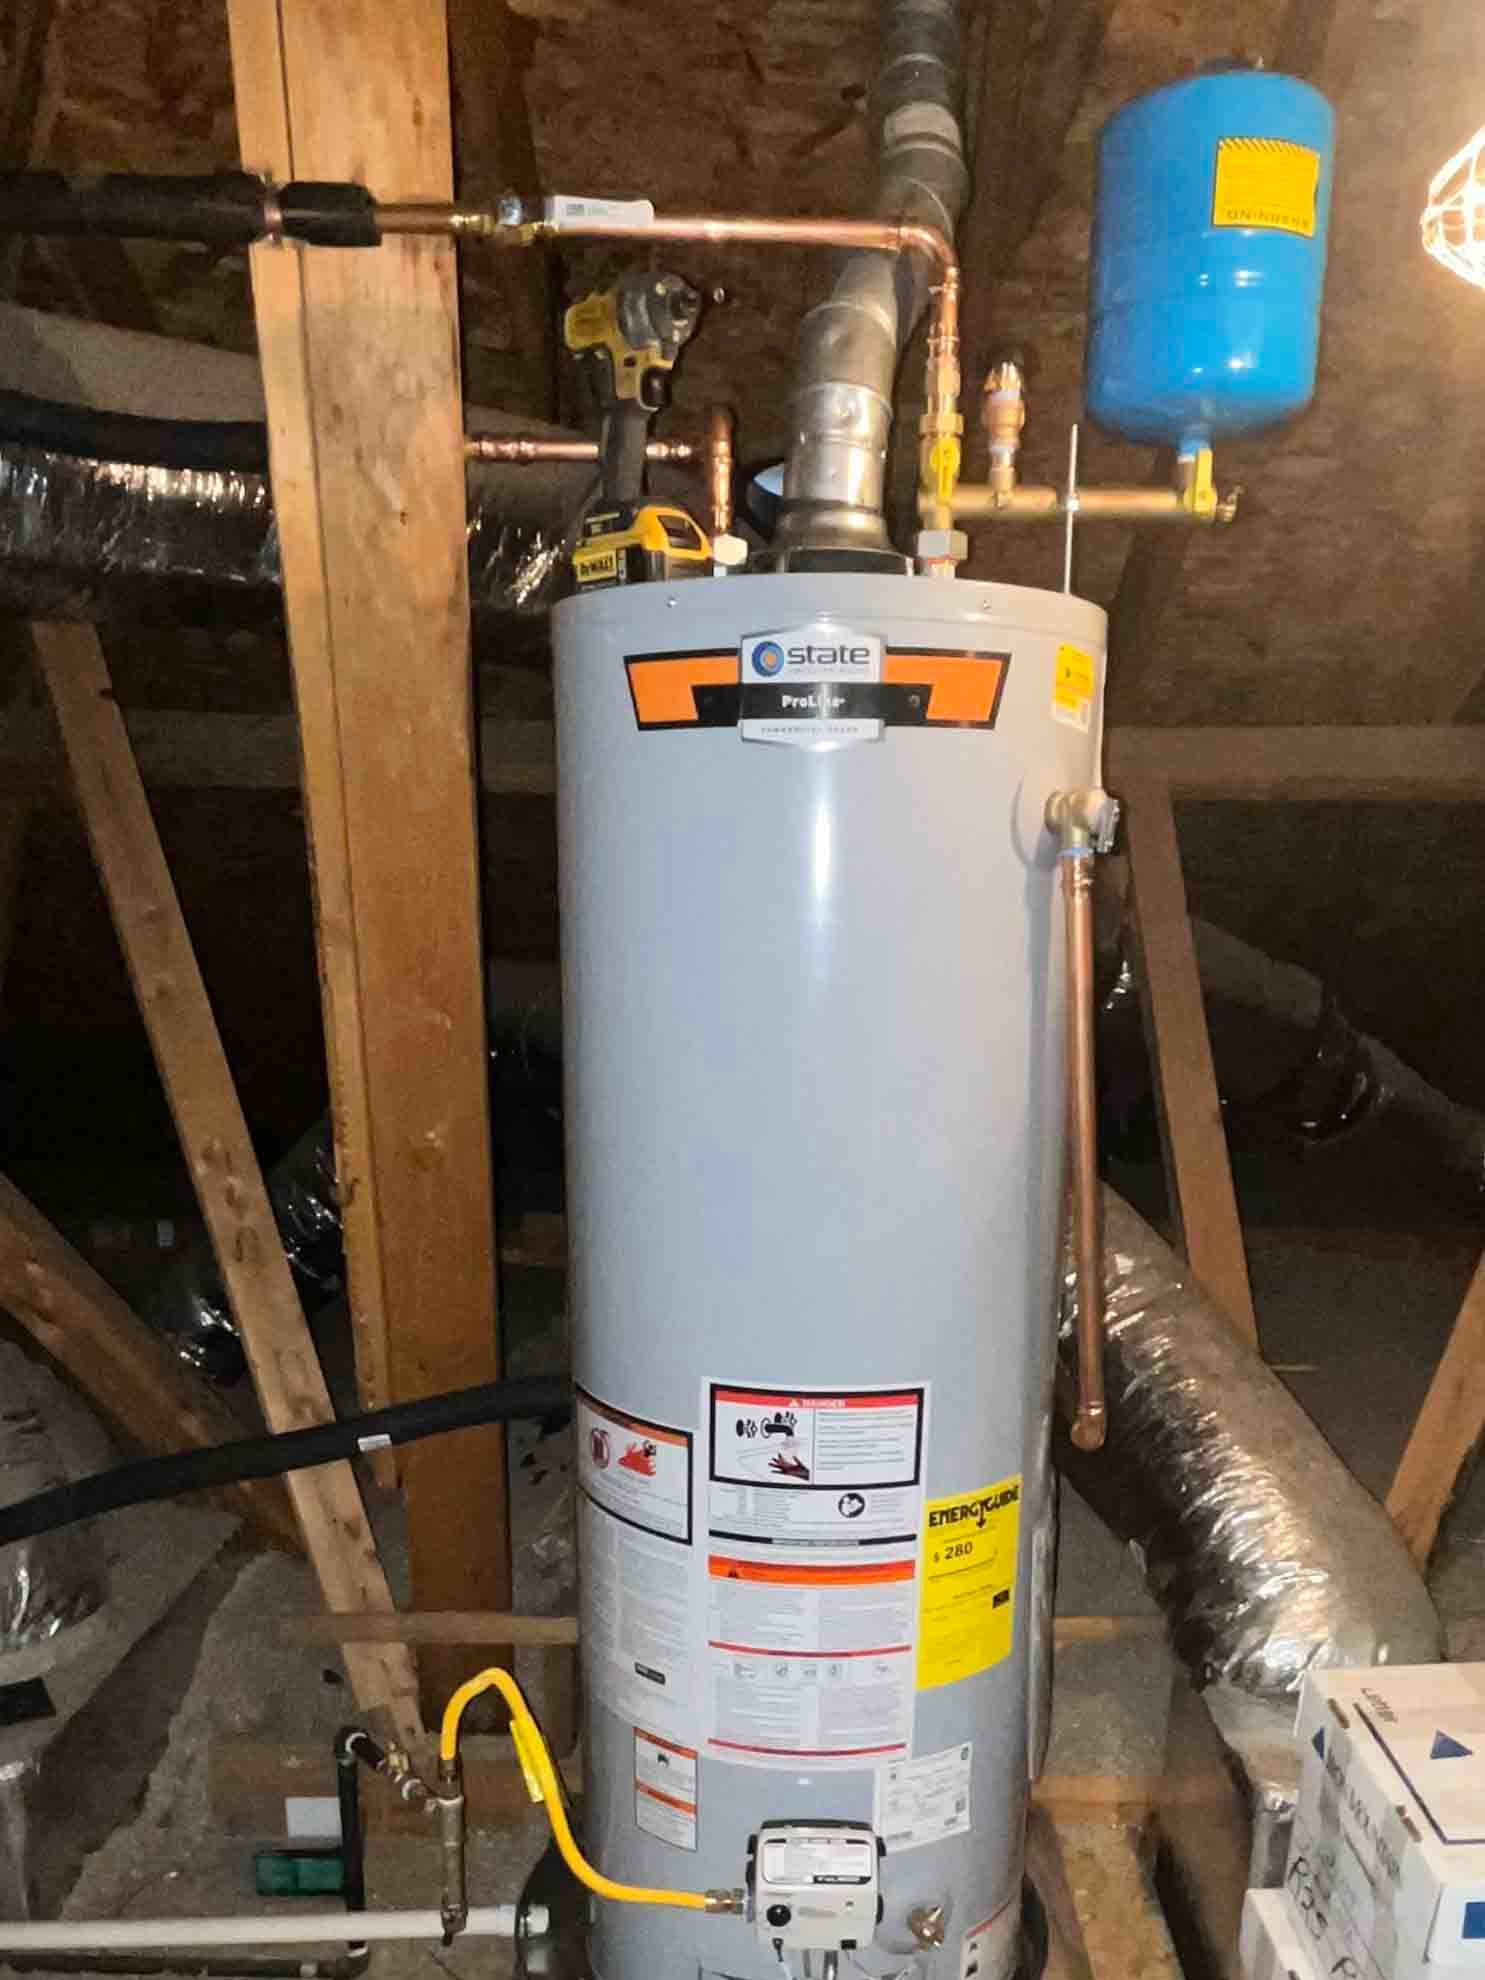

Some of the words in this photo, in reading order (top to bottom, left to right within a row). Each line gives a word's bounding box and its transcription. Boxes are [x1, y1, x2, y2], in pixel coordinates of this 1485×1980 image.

[787, 645, 870, 665] state
[781, 695, 842, 708] ProLie
[944, 1541, 973, 1560] 280
